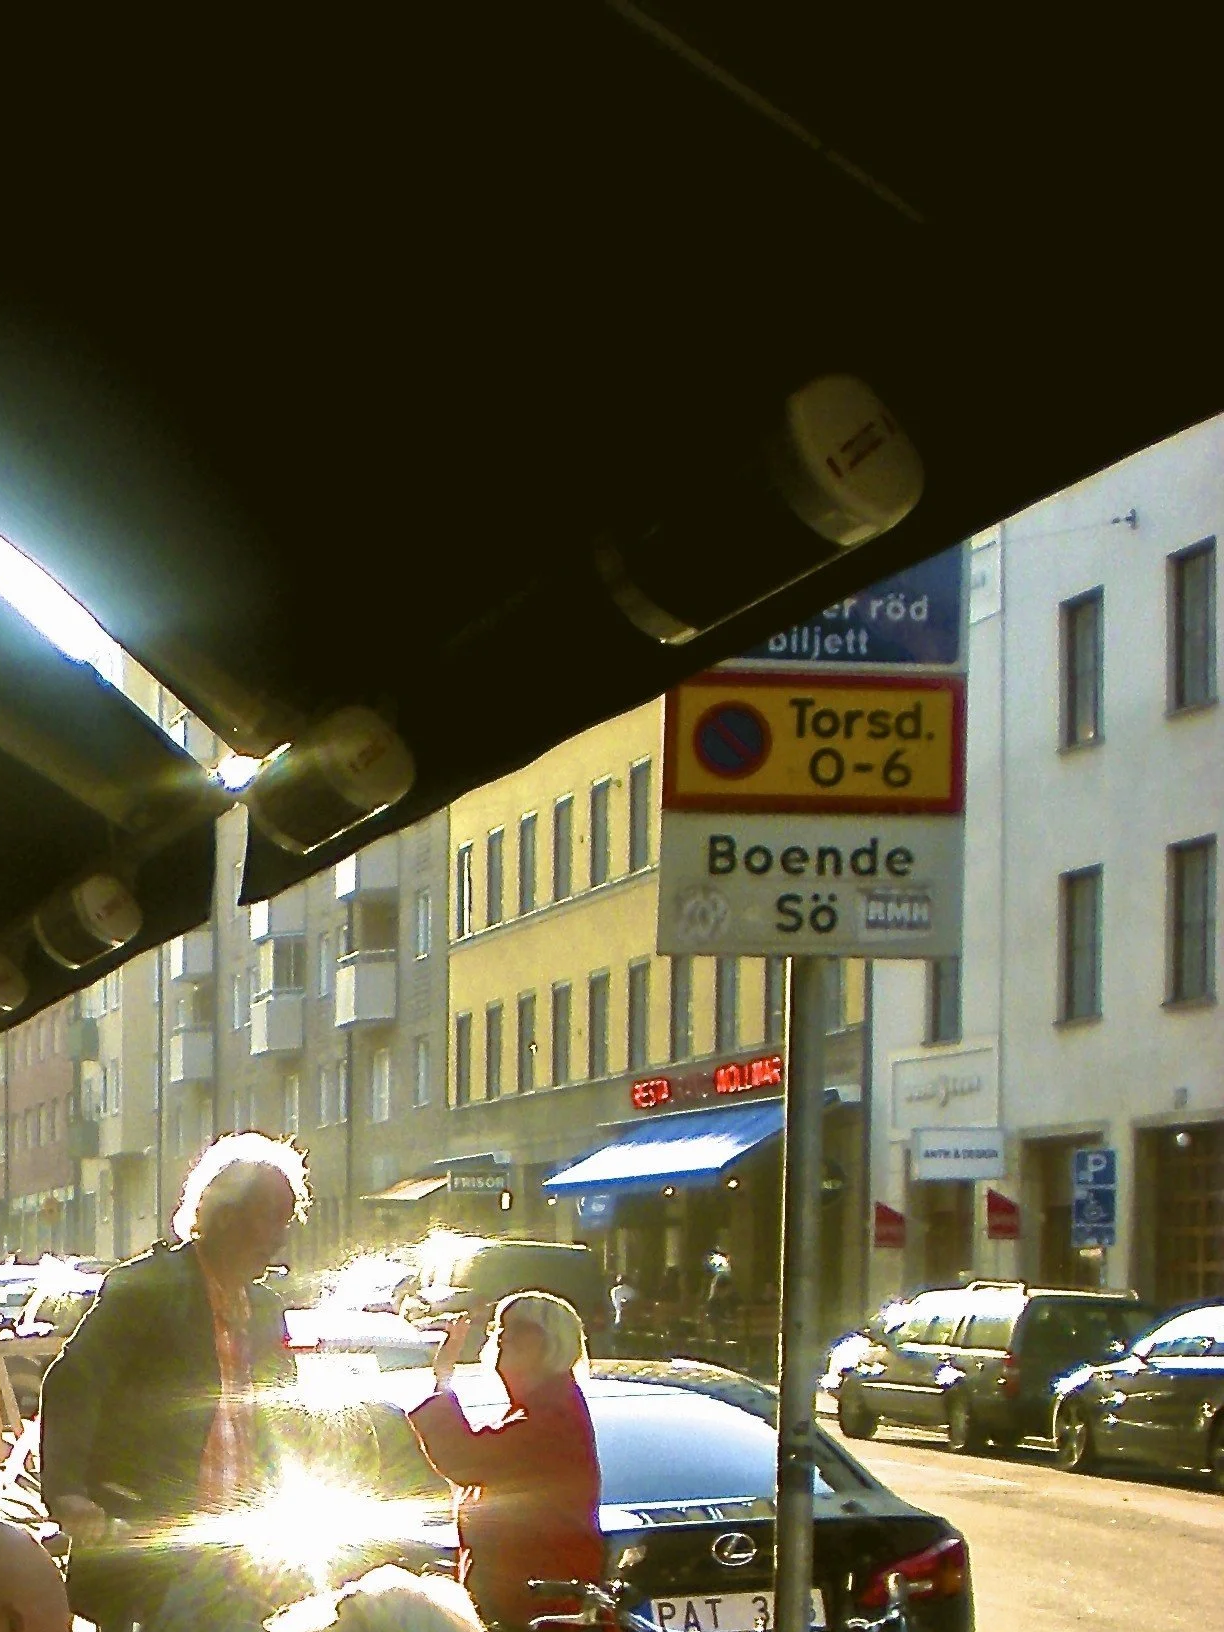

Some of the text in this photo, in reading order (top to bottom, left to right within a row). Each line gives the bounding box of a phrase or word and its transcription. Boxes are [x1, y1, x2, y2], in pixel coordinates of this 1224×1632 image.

[871, 592, 929, 622] röd
[790, 697, 935, 742] Torsd.
[707, 834, 914, 877] Boende
[776, 893, 838, 933] Sö
